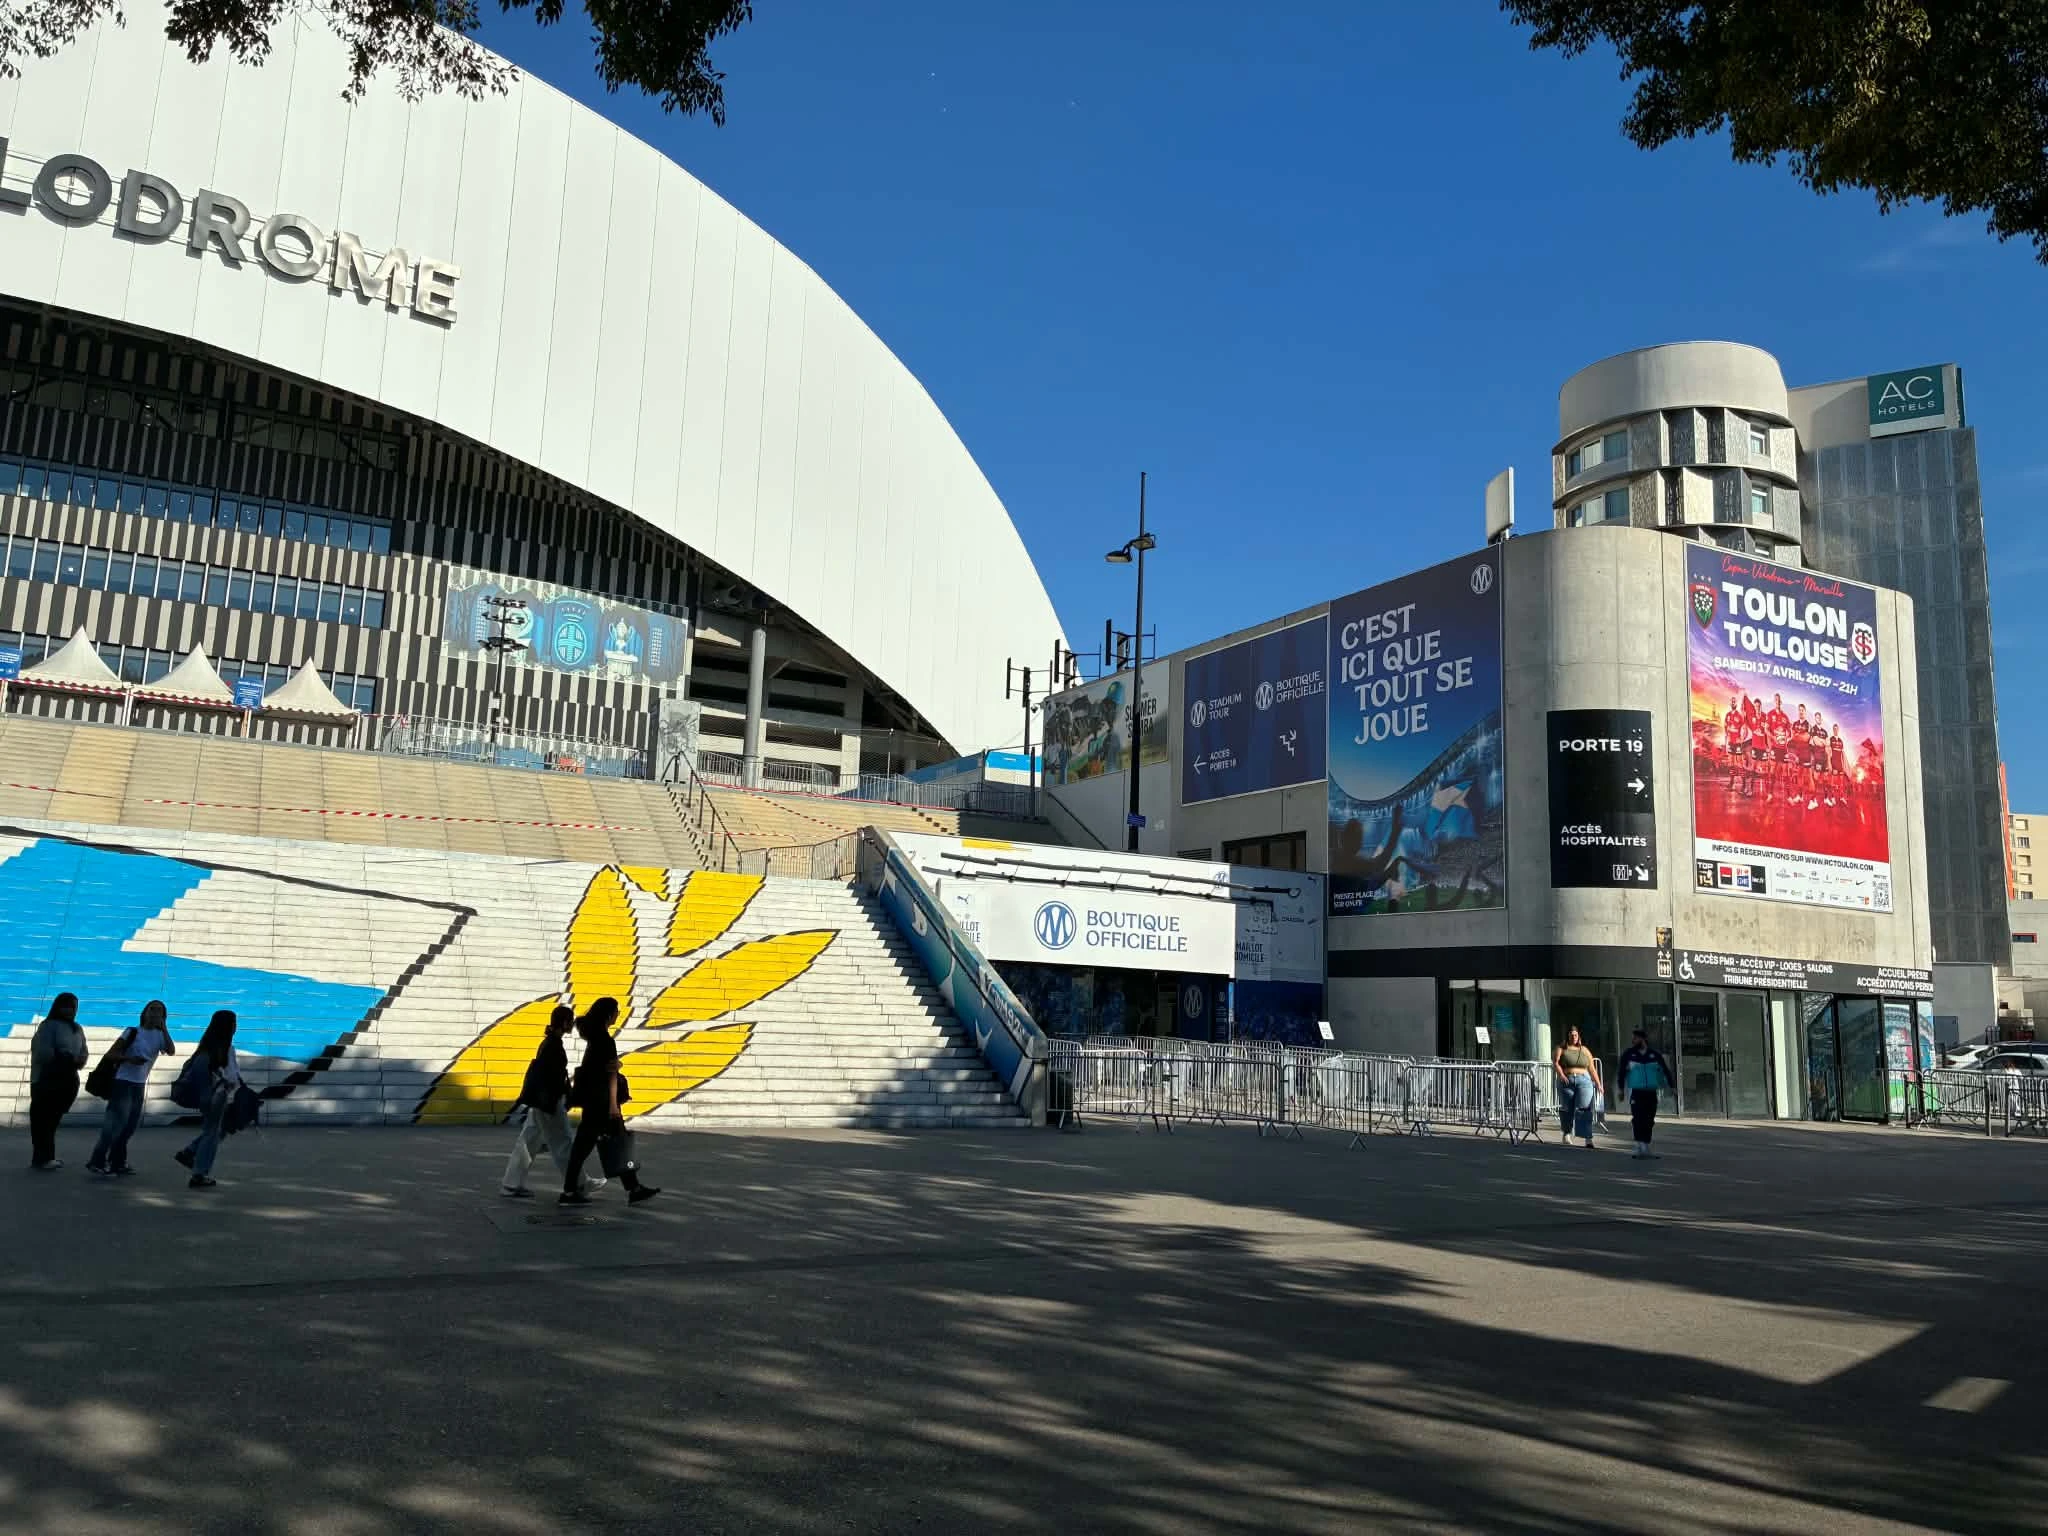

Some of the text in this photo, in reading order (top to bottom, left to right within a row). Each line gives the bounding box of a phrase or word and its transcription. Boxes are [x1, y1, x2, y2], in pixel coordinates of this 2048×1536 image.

[1879, 376, 1935, 406] AC
[1878, 400, 1936, 416] HOTELS
[1721, 581, 1847, 640] TOULON
[1341, 603, 1416, 650] C'EST
[1341, 629, 1441, 684] ICI QUE
[1723, 621, 1849, 671] TOULOUSE
[1276, 670, 1321, 692] BOUTIQUE
[1354, 657, 1473, 711] TOUT SE
[1713, 656, 1756, 673] SAMEDI
[1757, 662, 1771, 675] 17
[1772, 666, 1805, 682] AVRIL
[1806, 672, 1832, 688] 2027
[1839, 681, 1858, 696] 21H
[1208, 693, 1242, 711] STADIUM
[1276, 681, 1326, 704] OFFICIELLE
[1209, 707, 1230, 721] TOUR
[1354, 703, 1429, 745] JOUE
[1559, 739, 1644, 753] PORTE 19
[1561, 823, 1602, 834] ACCÈS
[1560, 834, 1647, 847] HOSPITALITÉS
[1711, 844, 1733, 855] INFOS
[1087, 910, 1180, 932] BOUTIQUE
[1086, 930, 1188, 952] OFFICIELLE
[1694, 953, 1719, 965] ACCÈS
[1764, 960, 1776, 970] VIP
[1780, 961, 1801, 974] LOGES
[1806, 963, 1833, 974] SALONS
[1877, 967, 1906, 978] ACCUEIL
[1723, 974, 1808, 989] TRIBUNE PRÉSIDENTIELLE
[1856, 976, 1915, 990] ACCRÉDITATIONS
